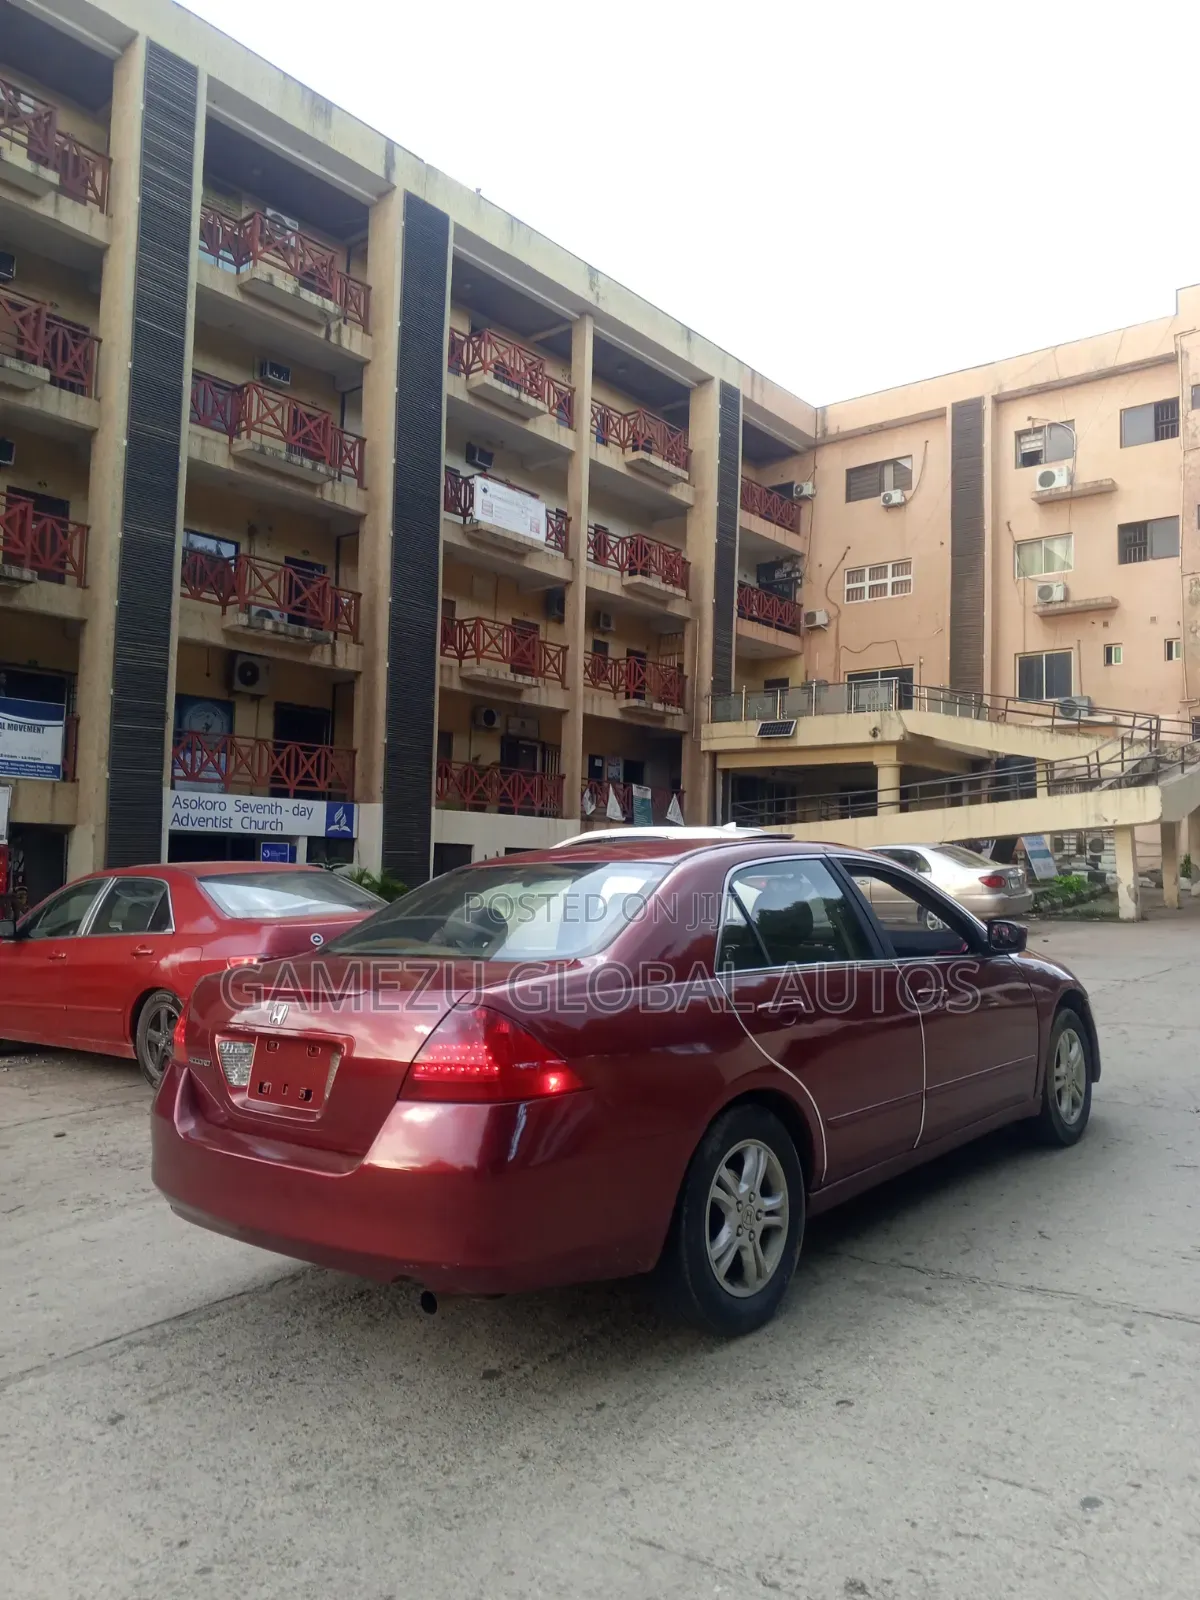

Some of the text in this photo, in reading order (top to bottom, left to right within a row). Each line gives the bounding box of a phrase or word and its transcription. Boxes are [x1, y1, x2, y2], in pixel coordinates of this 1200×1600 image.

[7, 723, 46, 734] MOVEMENT
[172, 795, 227, 812] Asokoro
[171, 812, 284, 832] Adventist Church
